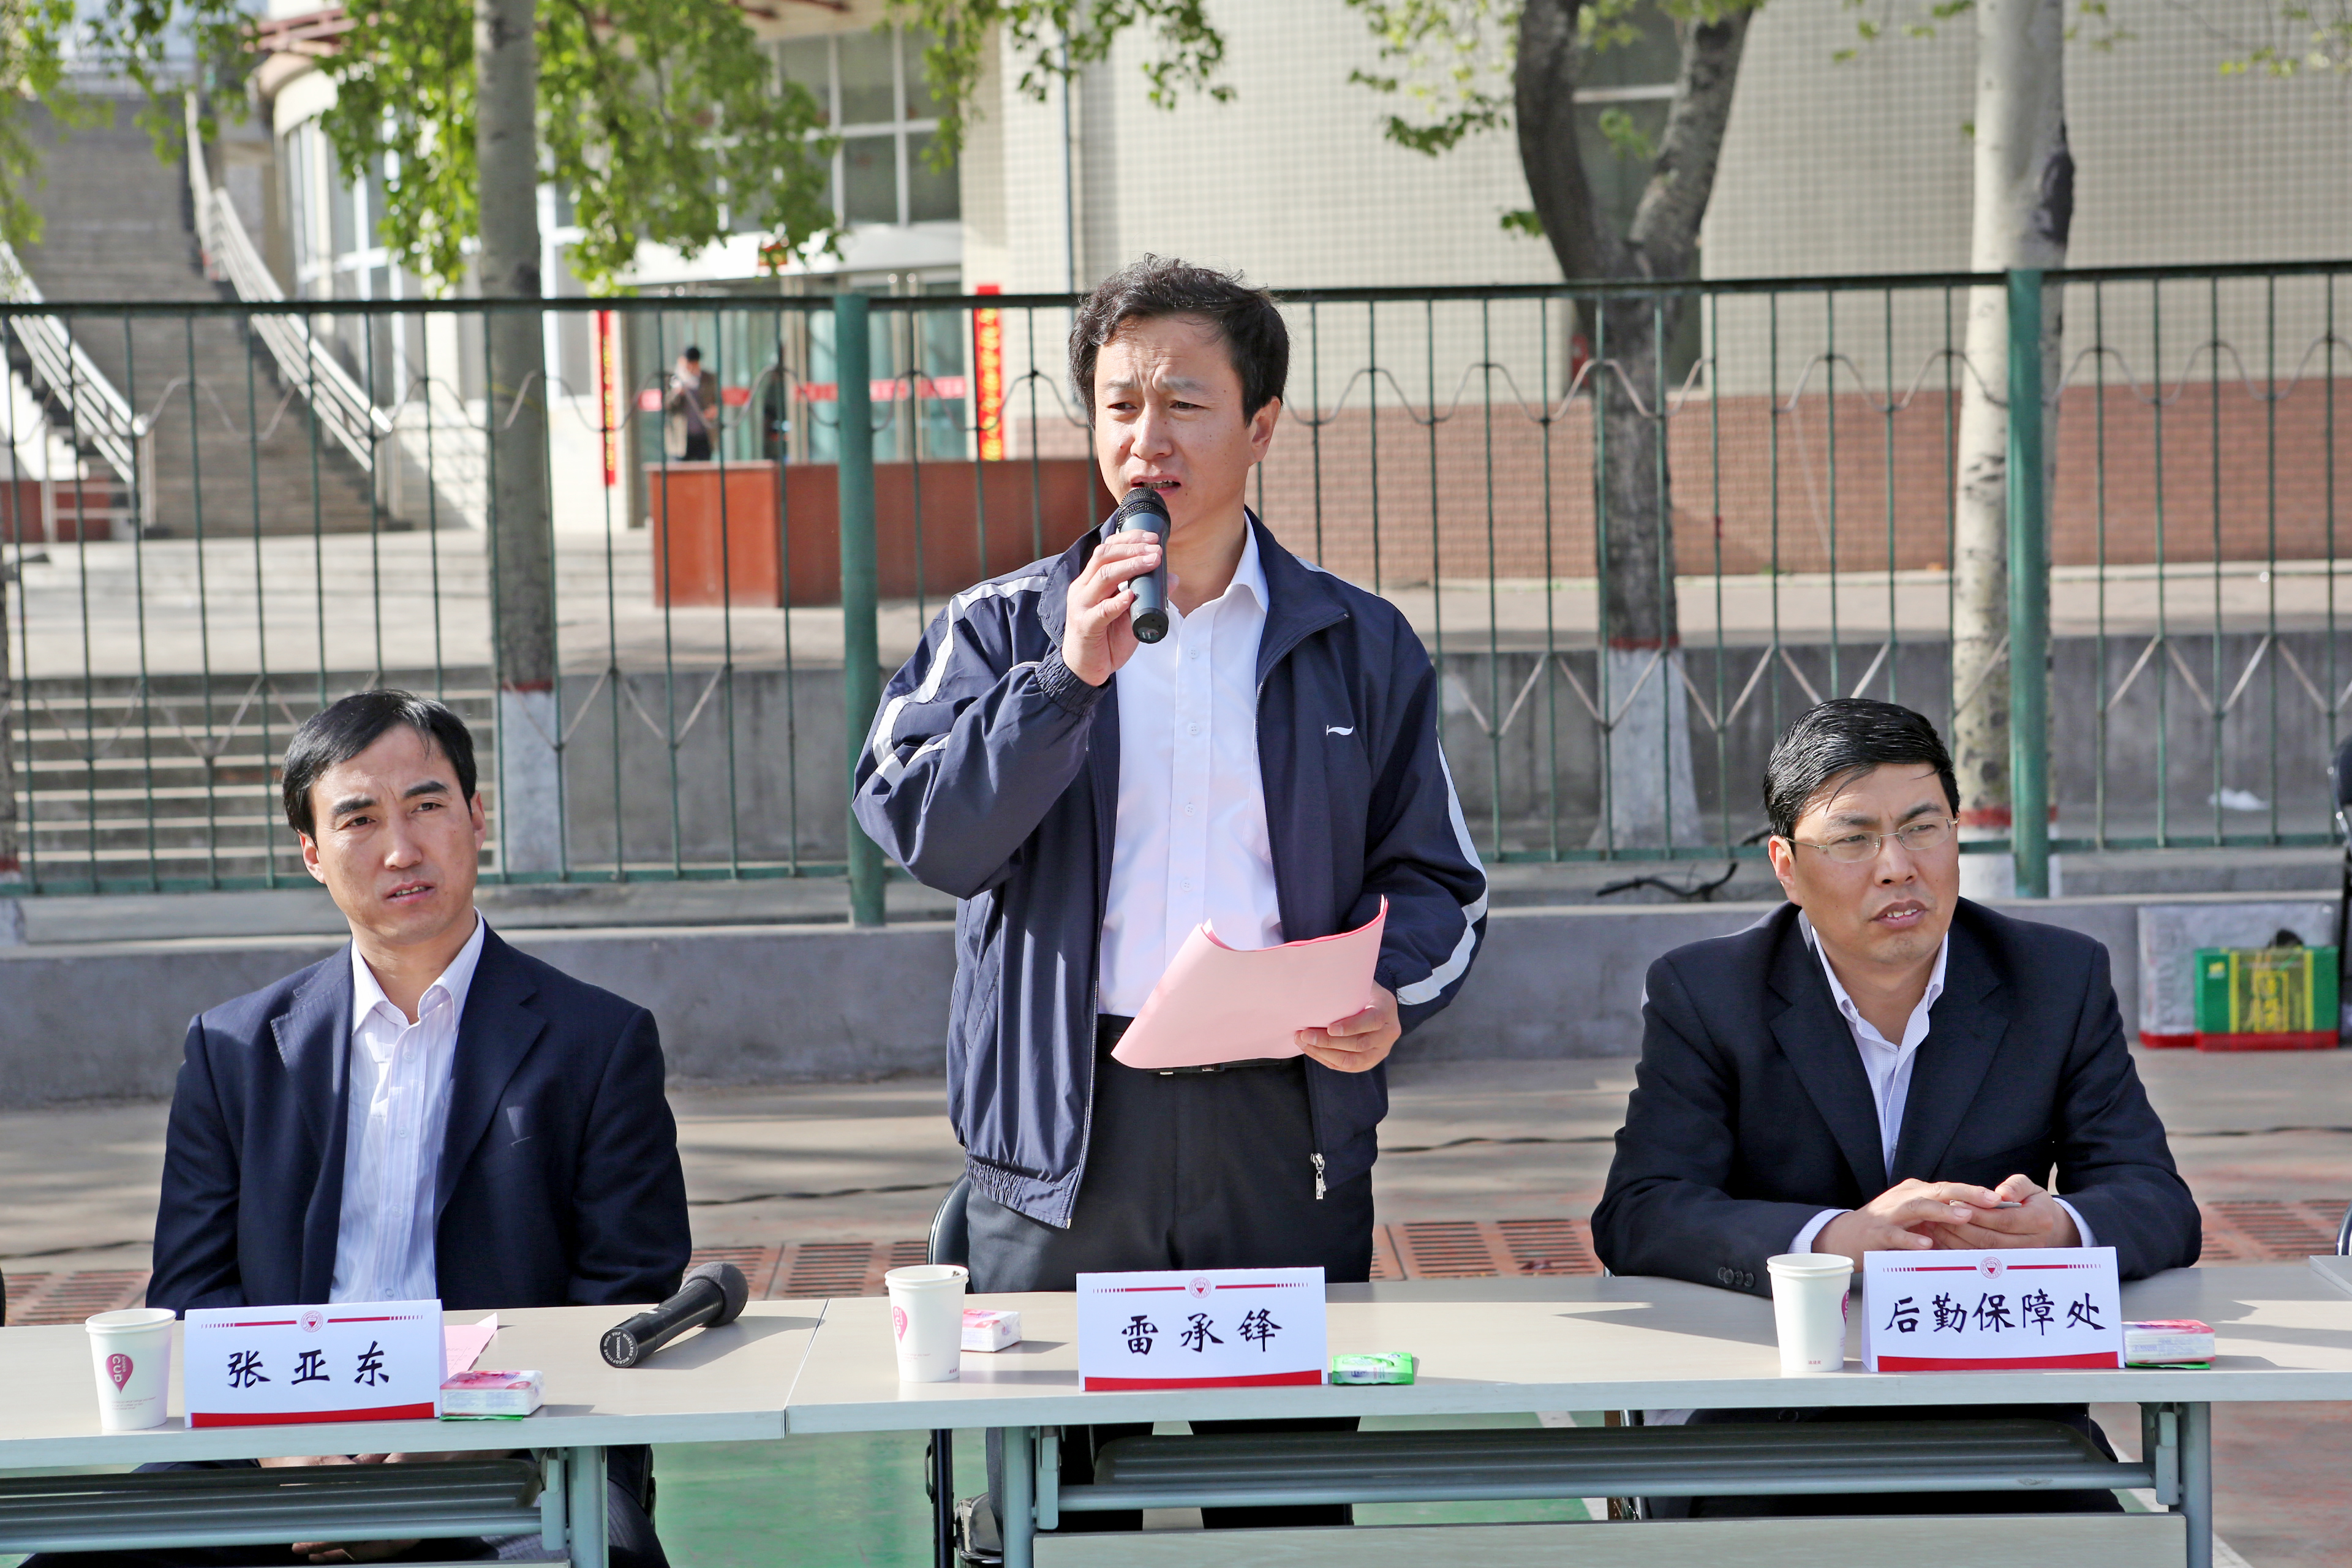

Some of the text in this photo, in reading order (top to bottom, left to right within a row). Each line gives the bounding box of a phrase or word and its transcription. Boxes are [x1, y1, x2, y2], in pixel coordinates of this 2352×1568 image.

[1884, 1288, 2106, 1336] 后勤保障处
[622, 1333, 634, 1357] WIRELESS
[1121, 1308, 1282, 1355] 雷承锋
[112, 1355, 123, 1382] CUP
[227, 1340, 390, 1389] 张亚东
[603, 1349, 630, 1364] MICROPHONE
